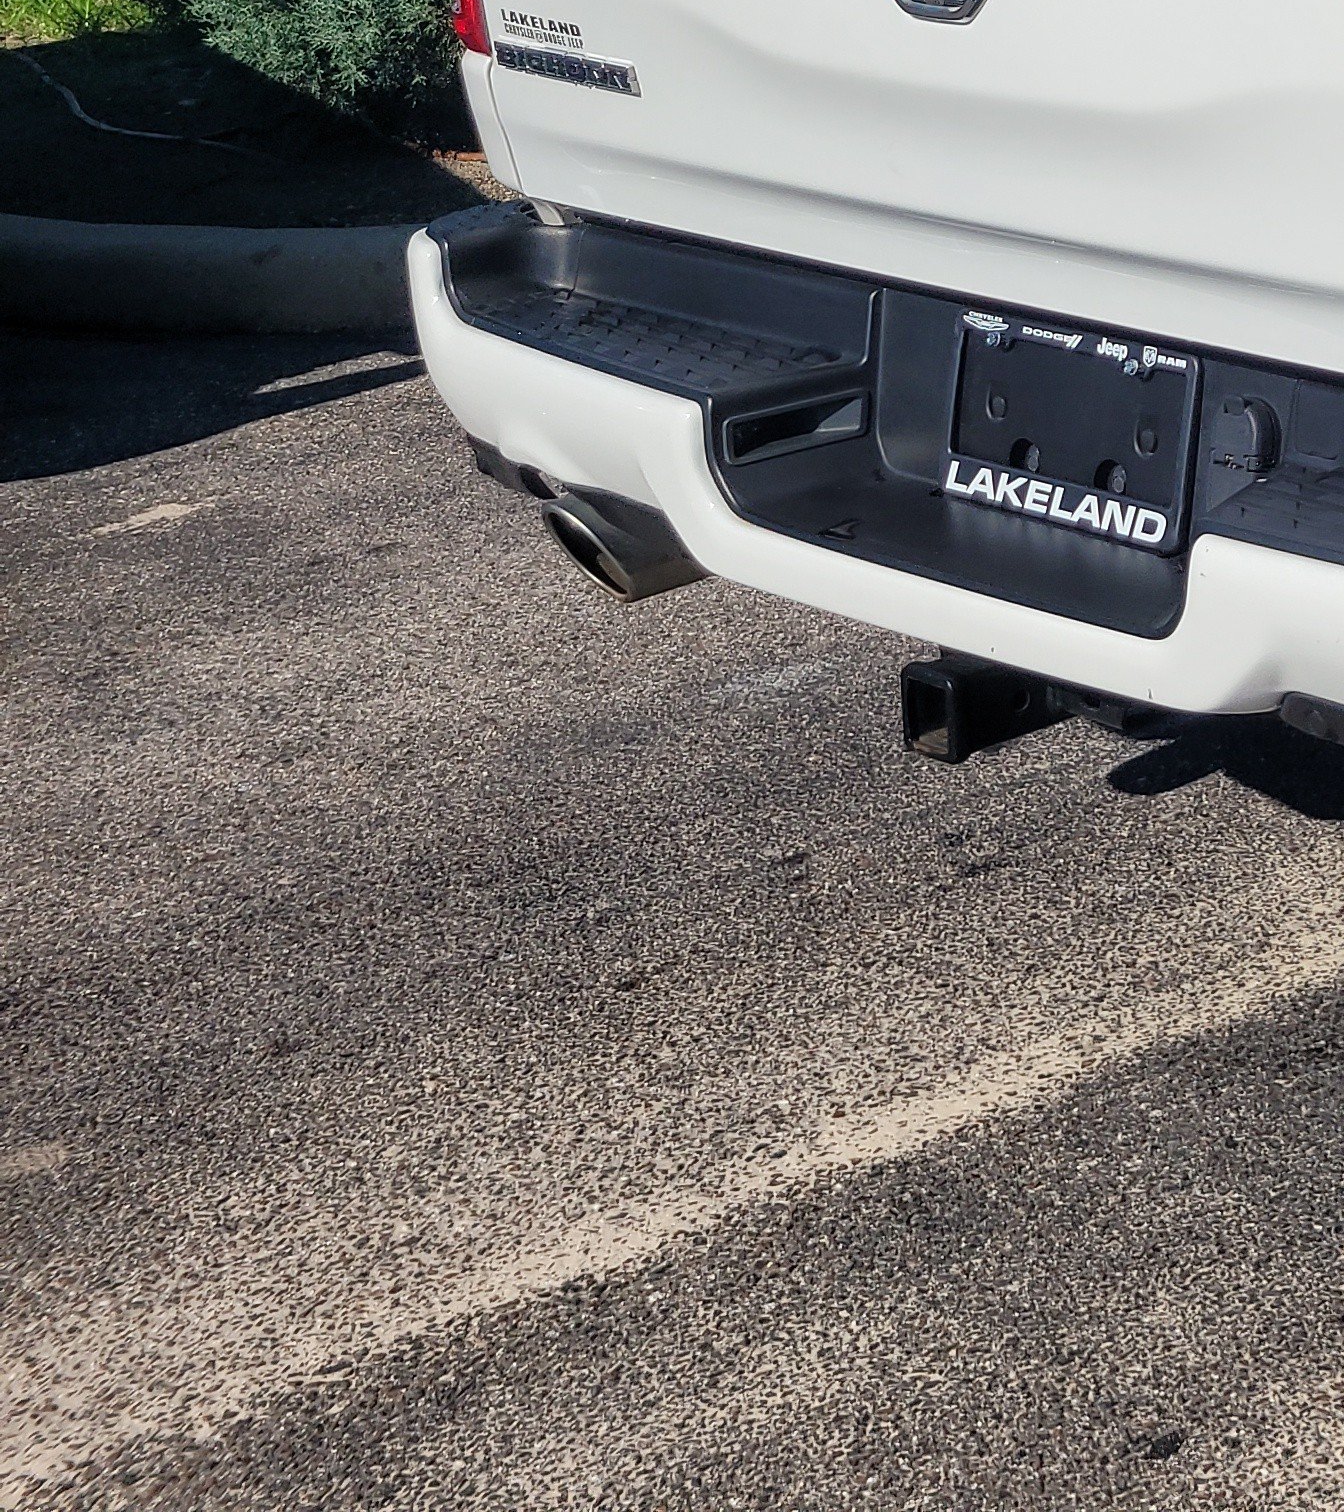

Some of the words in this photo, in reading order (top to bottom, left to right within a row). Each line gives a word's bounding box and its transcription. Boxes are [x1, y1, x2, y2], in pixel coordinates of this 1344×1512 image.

[500, 8, 582, 37] LAKELAND
[968, 310, 1003, 323] CHRYSLER
[1022, 325, 1074, 344] DODGE
[1097, 337, 1128, 361] Jeep
[1157, 354, 1187, 369] RAM
[945, 460, 1167, 544] LAKELAND
